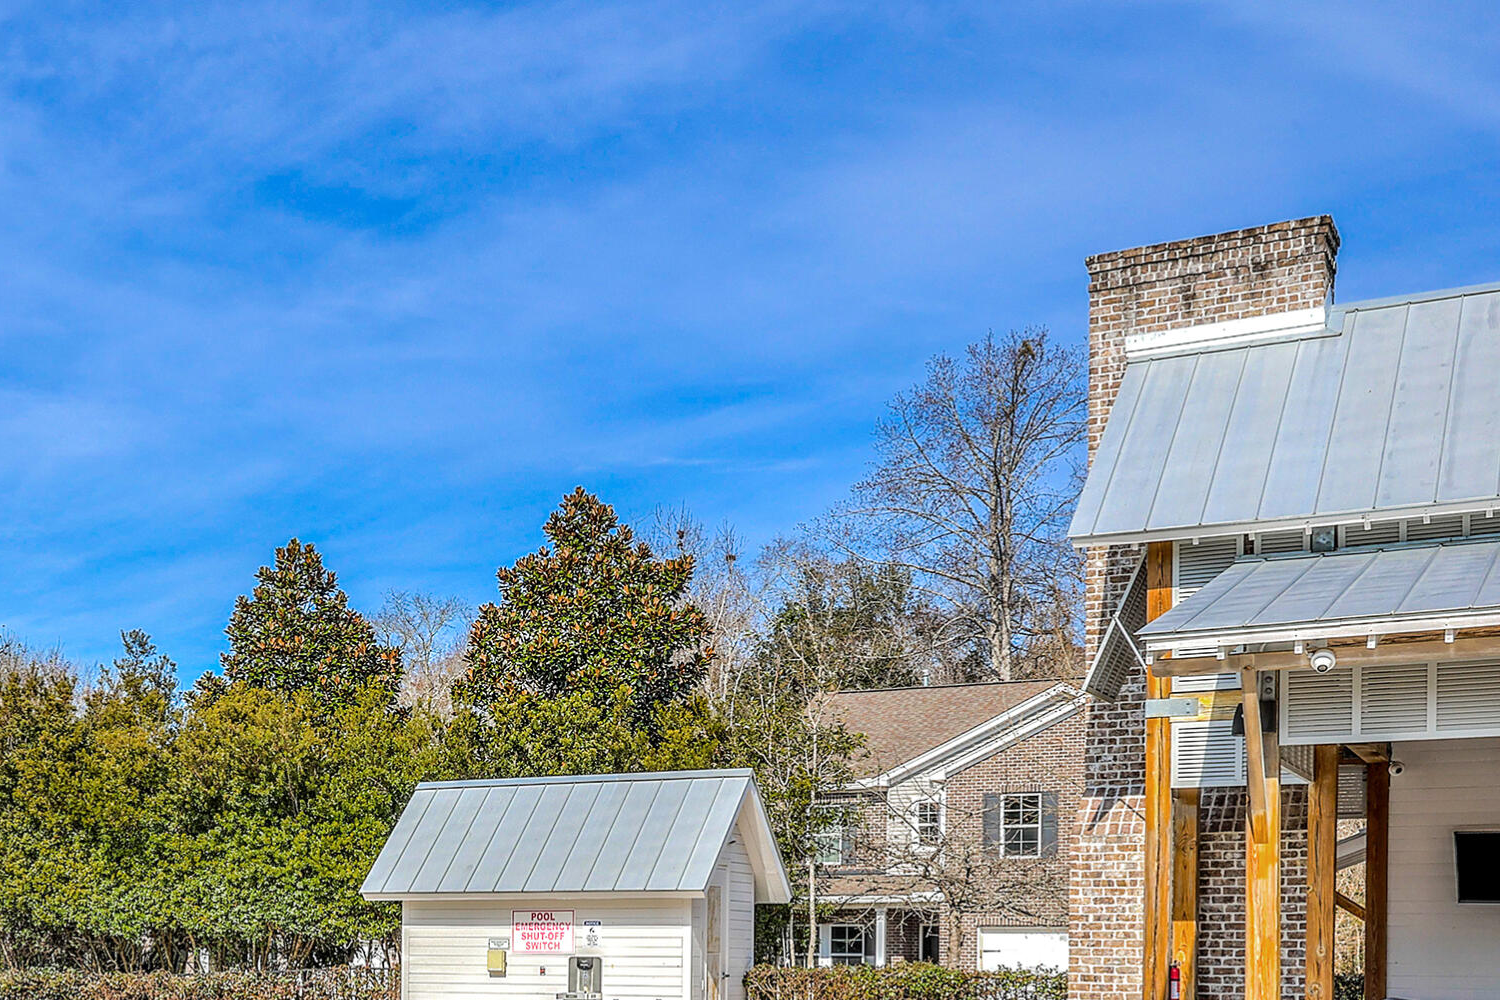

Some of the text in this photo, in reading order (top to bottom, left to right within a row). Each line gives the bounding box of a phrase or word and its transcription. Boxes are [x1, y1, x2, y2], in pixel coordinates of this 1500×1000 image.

[531, 912, 555, 921] POOL
[515, 922, 571, 931] EMERGENCY
[521, 931, 565, 940] SHUT-OFF
[525, 941, 560, 950] SWITCH
